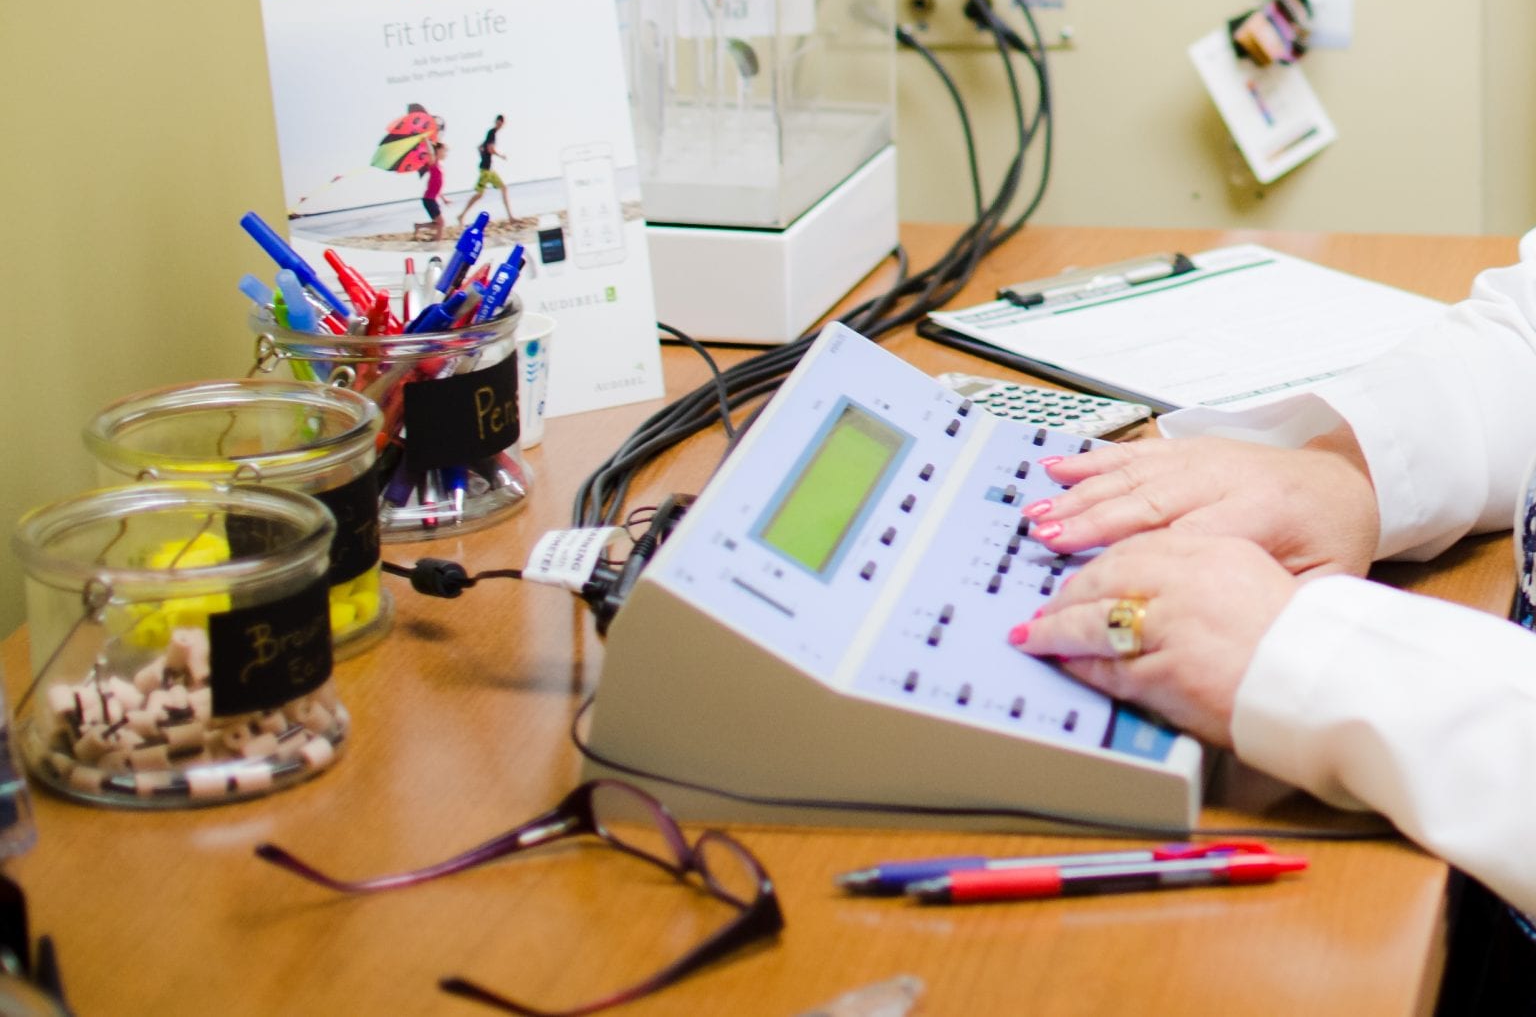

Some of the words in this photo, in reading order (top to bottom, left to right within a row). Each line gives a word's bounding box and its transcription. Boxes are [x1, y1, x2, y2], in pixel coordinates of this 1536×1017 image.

[383, 21, 416, 48] Fit
[419, 16, 457, 43] for
[463, 8, 508, 38] Life
